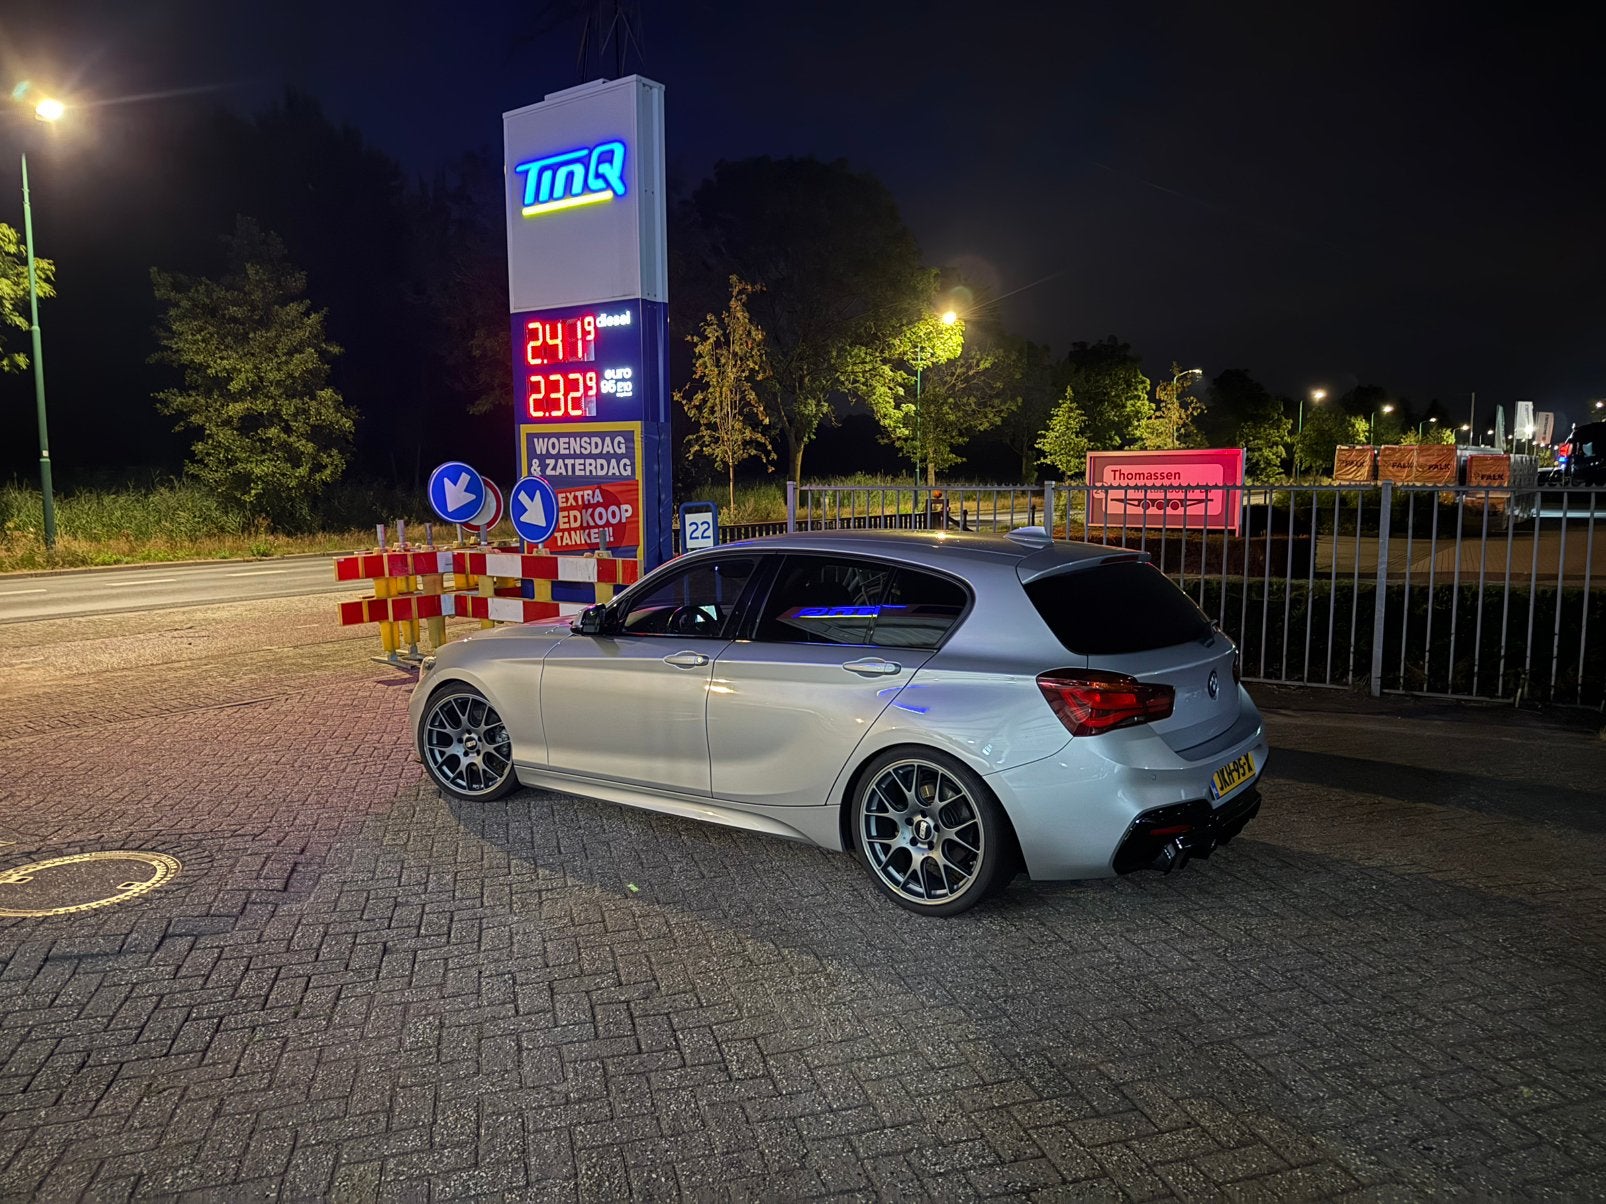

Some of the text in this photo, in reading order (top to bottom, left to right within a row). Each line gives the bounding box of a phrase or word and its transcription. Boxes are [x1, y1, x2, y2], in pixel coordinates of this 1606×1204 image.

[596, 310, 631, 328] diesel
[604, 368, 632, 380] euro
[533, 435, 626, 455] WOENSDAG
[530, 458, 632, 476] & ZATERDAG
[1111, 469, 1181, 481] Thomassen
[557, 488, 603, 507] EXTRA
[558, 504, 633, 529] EDKOOP
[688, 520, 712, 541] 22
